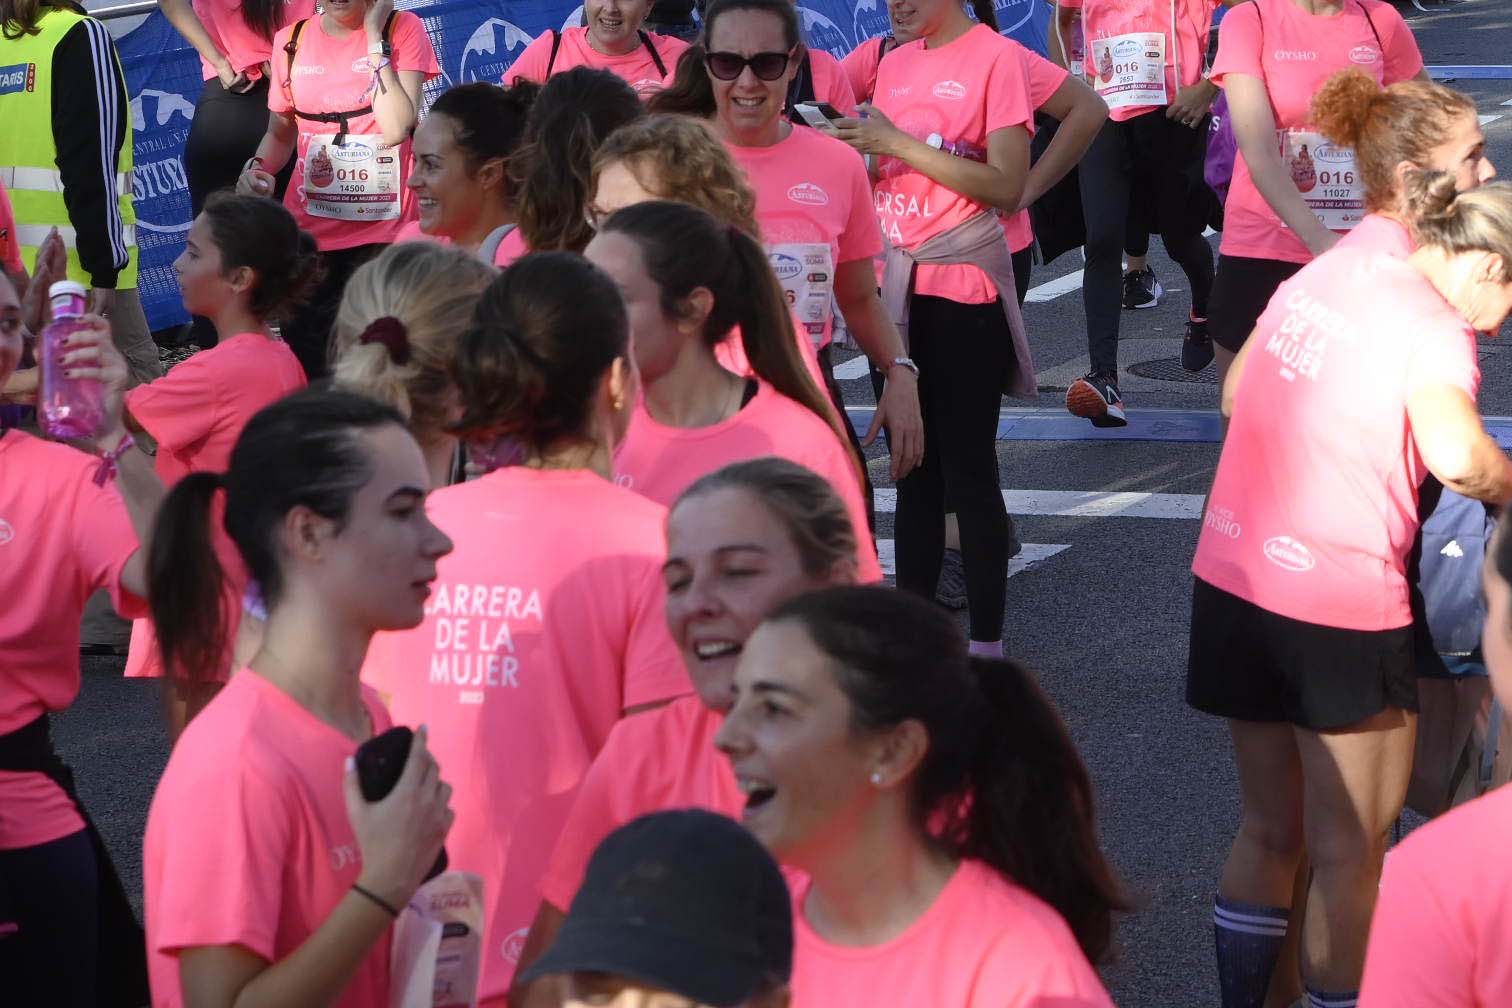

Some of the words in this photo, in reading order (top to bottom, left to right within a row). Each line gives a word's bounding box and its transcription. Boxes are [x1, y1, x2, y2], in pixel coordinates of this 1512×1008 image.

[1274, 49, 1317, 61] OYSHO
[1115, 61, 1139, 75] 016
[336, 168, 369, 181] 016
[1319, 171, 1354, 185] 016
[340, 184, 365, 192] 14500
[1323, 189, 1351, 198] 11027
[424, 584, 544, 622] ARRERA
[435, 618, 469, 650] DE
[480, 621, 515, 653] LA
[429, 654, 521, 689] MUJER
